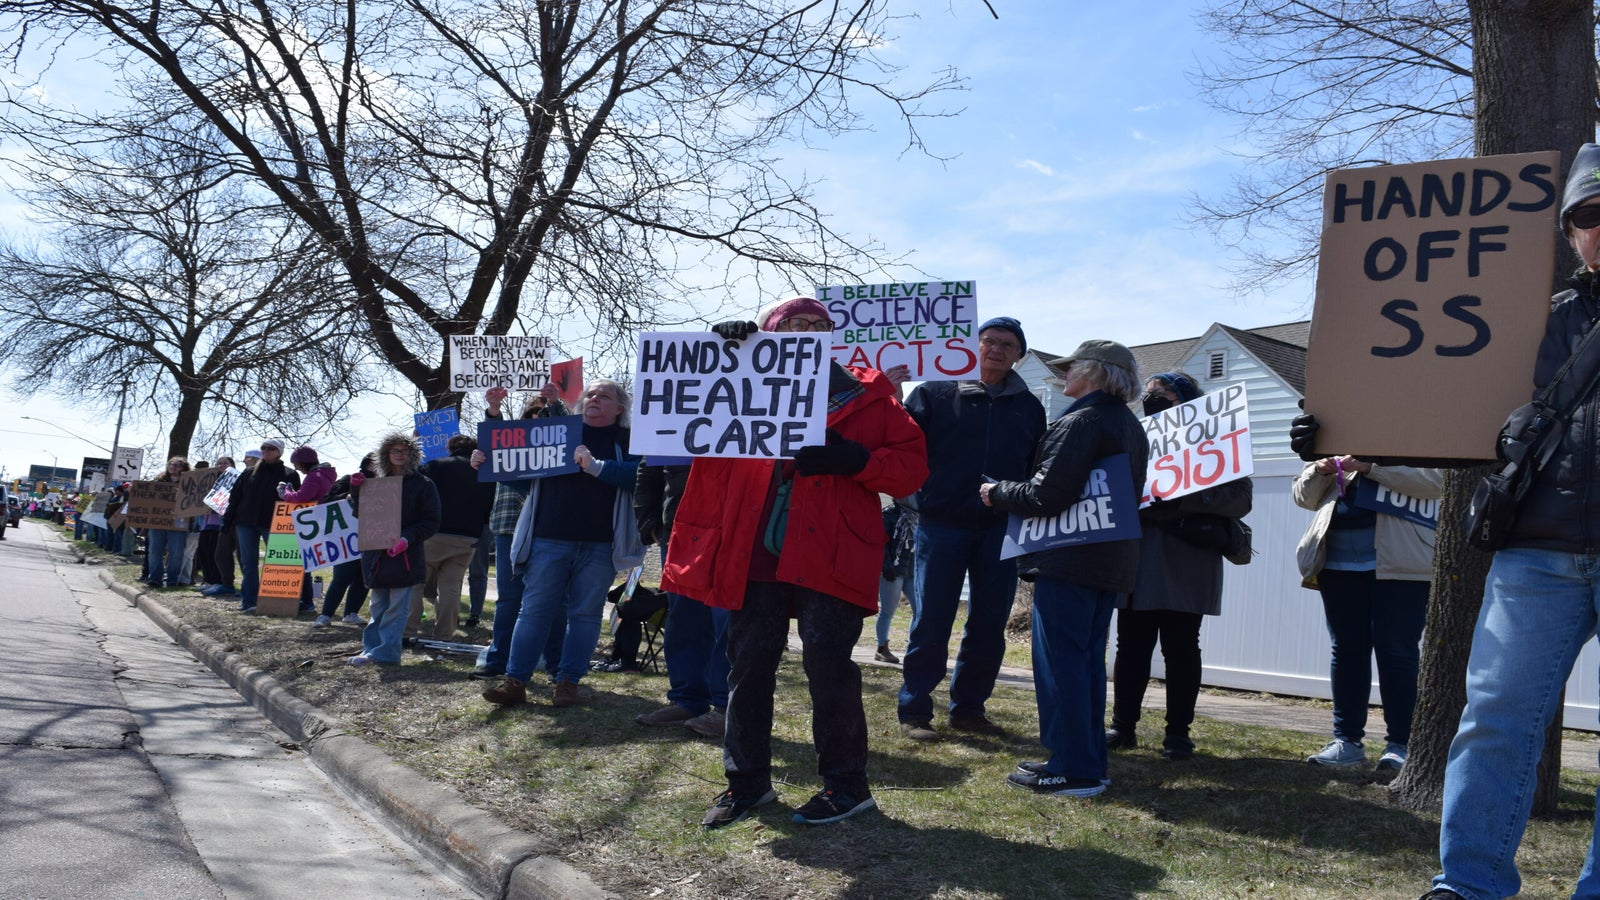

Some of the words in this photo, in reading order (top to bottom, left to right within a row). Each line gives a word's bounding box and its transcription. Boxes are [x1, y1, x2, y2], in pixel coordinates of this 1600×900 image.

[1332, 162, 1557, 224] HANDS
[1363, 225, 1510, 282] OFF
[819, 287, 832, 300] I
[843, 282, 928, 300] BELIEVE
[940, 281, 971, 296] IN
[828, 295, 973, 331] SCIENCE
[844, 324, 927, 344] BELIEVE
[936, 324, 971, 339] IN
[1370, 295, 1491, 358] SS
[452, 336, 488, 347] WHEN
[493, 336, 551, 348] INJUSTICE
[460, 347, 514, 360] BECOMES
[517, 349, 545, 359] LAW
[474, 360, 549, 374] RESISTANCE
[640, 339, 740, 375] HANDS
[752, 337, 822, 375] OFF!
[454, 373, 514, 388] BECOMES
[518, 374, 551, 389] DUTY
[640, 376, 816, 417] HEALTH
[1205, 385, 1243, 416] UP
[417, 409, 456, 427] INVEST
[433, 425, 442, 433] IN
[1185, 405, 1246, 445] OUT
[491, 427, 526, 449] FOR
[530, 424, 568, 447] OUR
[491, 444, 567, 474] FUTURE
[291, 579, 301, 587] of
